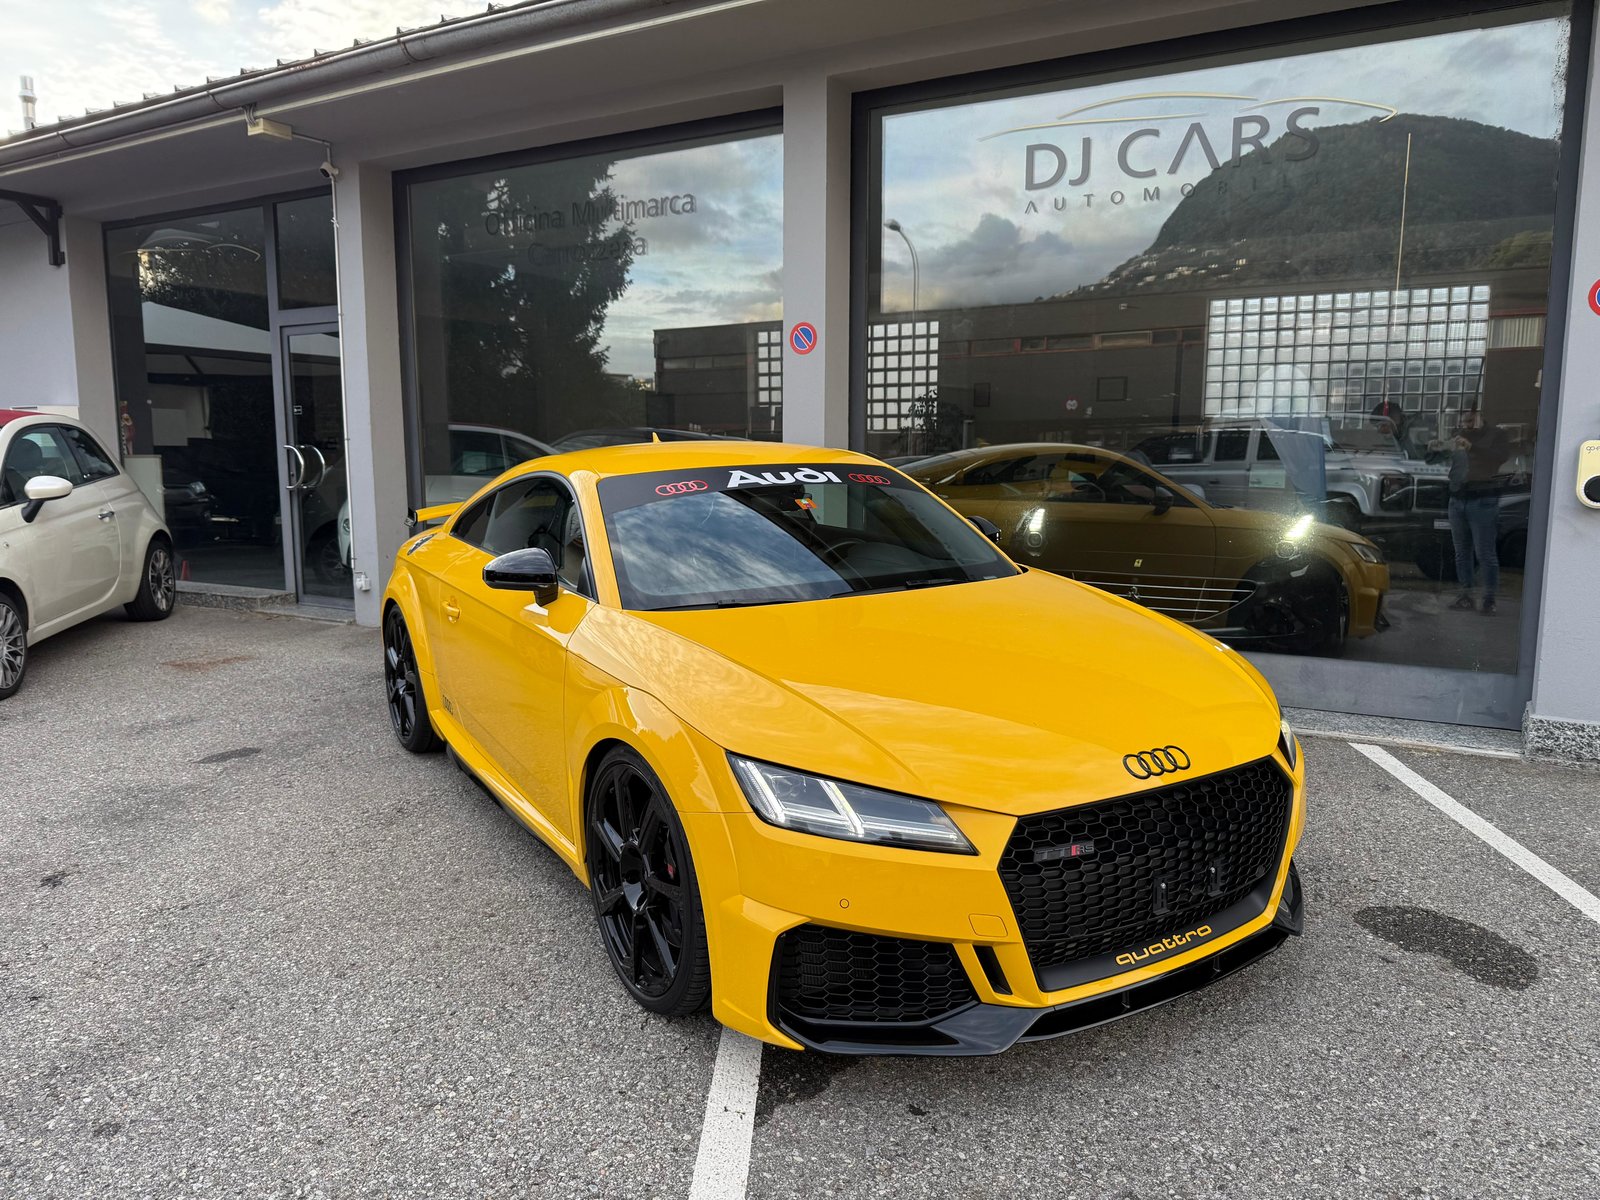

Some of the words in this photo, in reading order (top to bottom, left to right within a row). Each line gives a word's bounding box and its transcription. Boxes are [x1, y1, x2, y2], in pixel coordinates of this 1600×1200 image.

[1024, 136, 1091, 191] DJ
[1116, 106, 1321, 180] CARS
[484, 205, 564, 236] Officina
[726, 467, 843, 488] Audi
[1115, 924, 1213, 966] quattro
